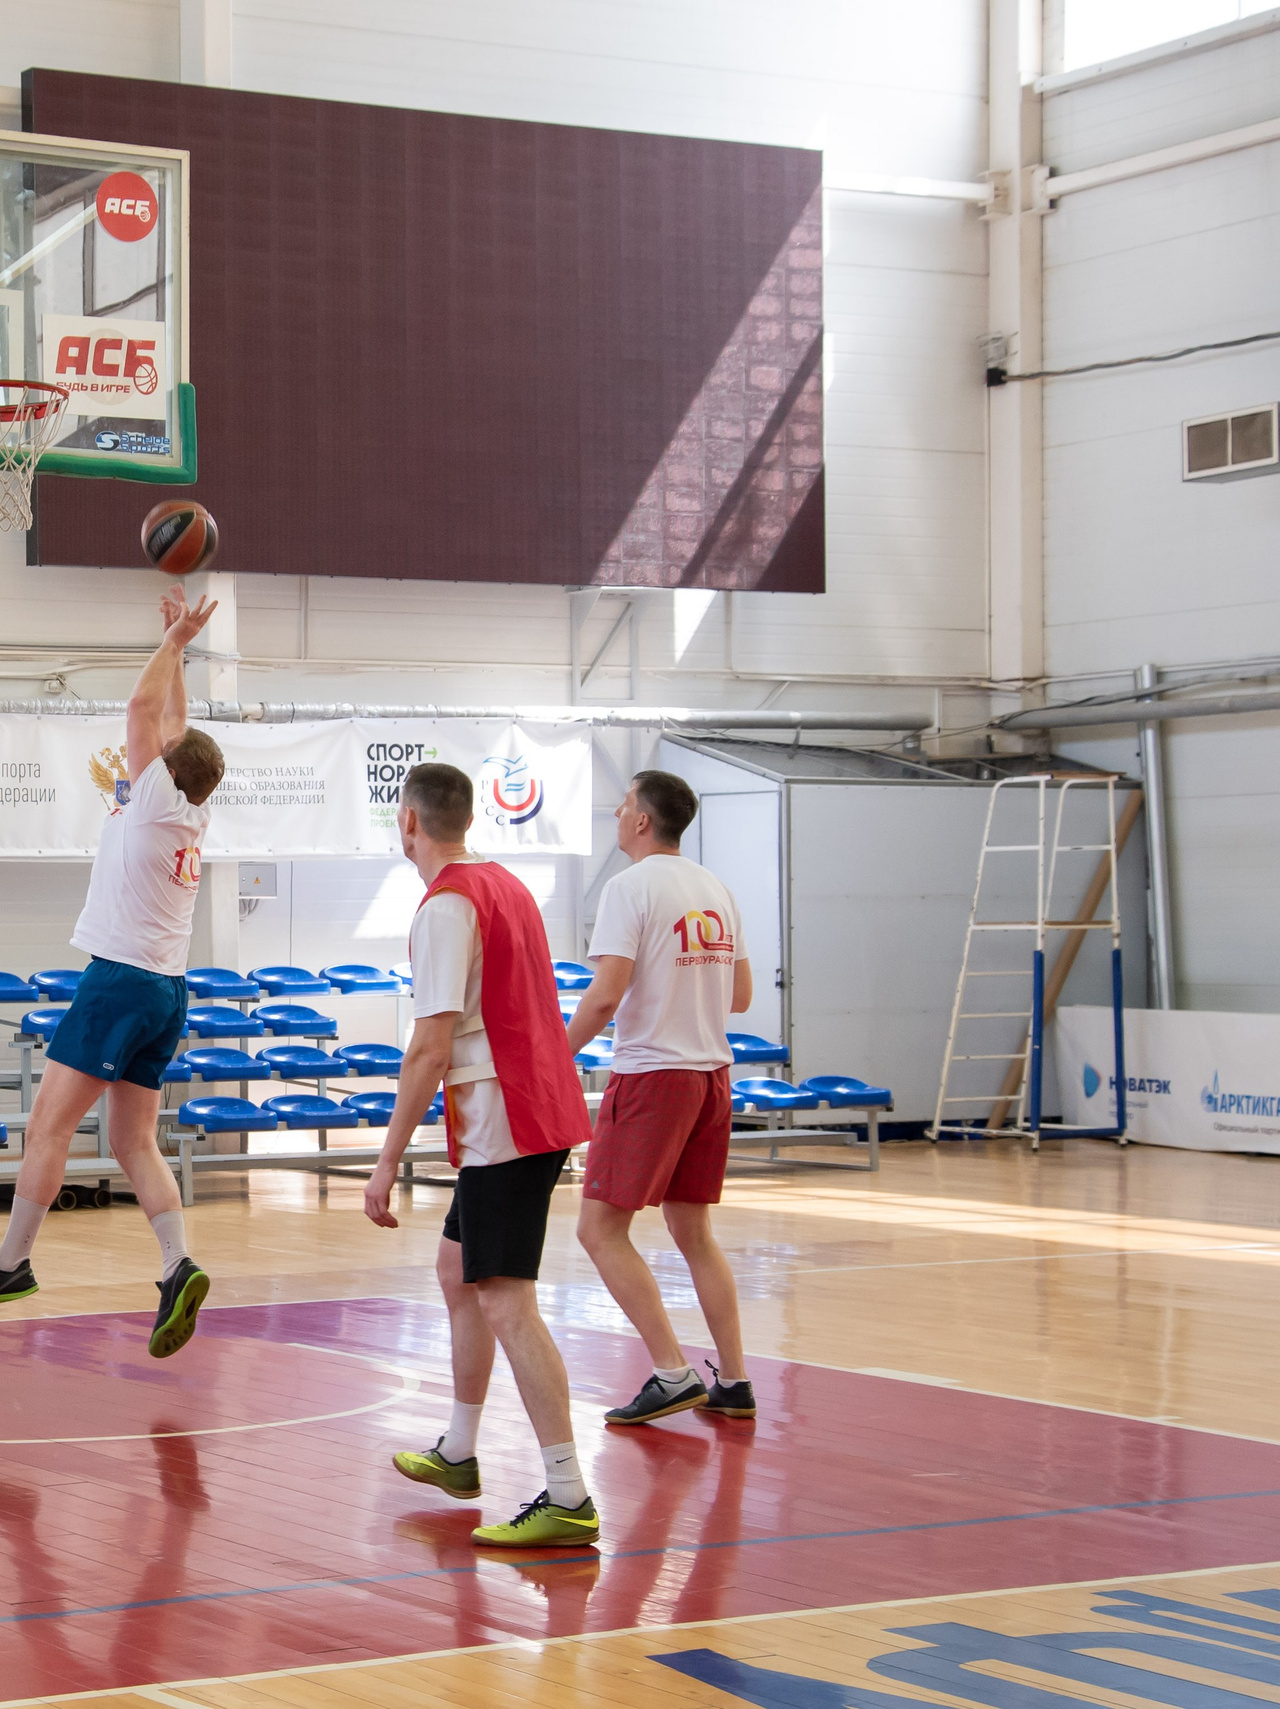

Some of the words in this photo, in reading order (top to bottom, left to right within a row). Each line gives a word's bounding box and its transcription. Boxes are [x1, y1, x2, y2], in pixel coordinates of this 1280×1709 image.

[105, 197, 151, 221] АСБ
[55, 335, 157, 388] АСБ
[90, 383, 99, 392] В
[100, 384, 131, 394] ИГРЕ
[367, 743, 425, 762] СПОРТ
[224, 766, 273, 778] ТЕРСТВО
[275, 766, 315, 777] НАУКИ
[216, 781, 248, 792] ШЕГО
[249, 780, 326, 792] ОБРАЗОВАНИЯ
[210, 793, 258, 806] ИЙСКОЙ
[260, 794, 325, 806] ФЕДЕРАЦИИ
[368, 785, 403, 803] ЖИ
[369, 807, 398, 817] ФЕДЕР
[370, 819, 397, 828] ПРОЕК
[1109, 1075, 1171, 1095] НВАТЭК
